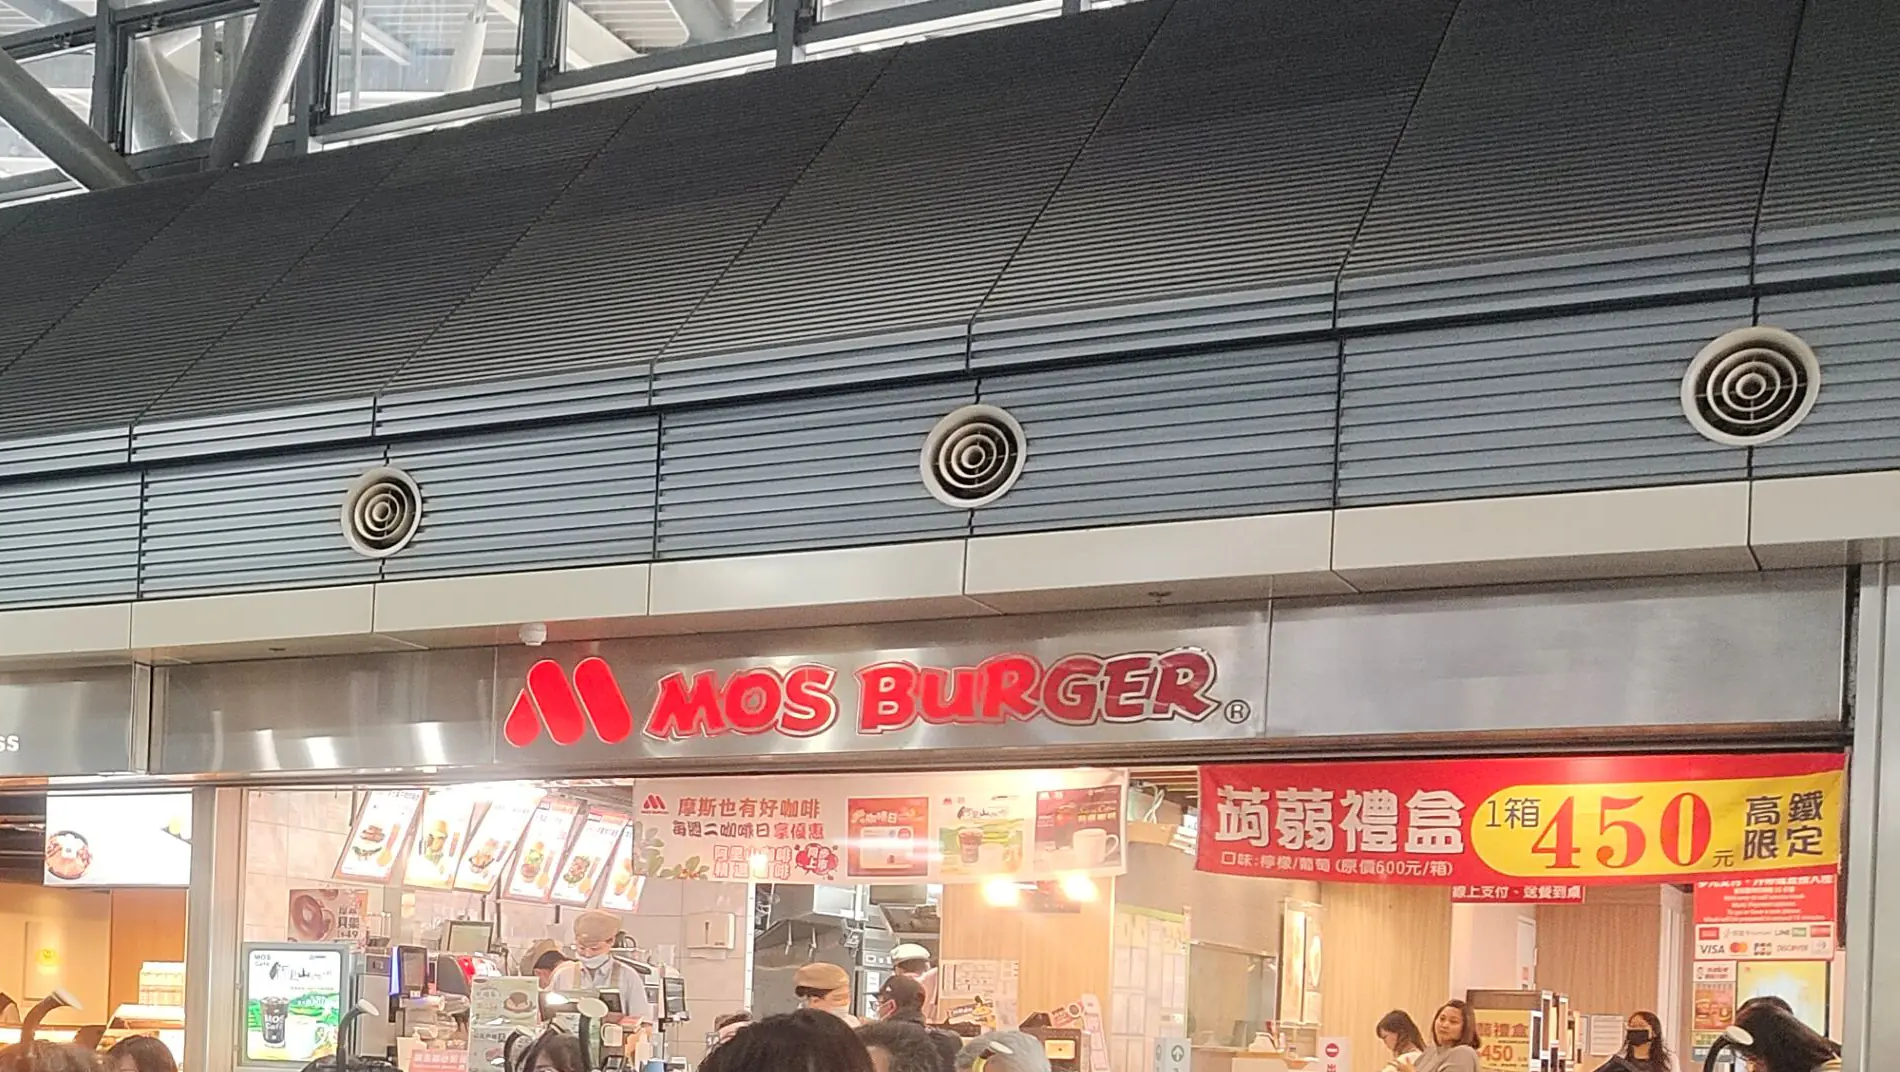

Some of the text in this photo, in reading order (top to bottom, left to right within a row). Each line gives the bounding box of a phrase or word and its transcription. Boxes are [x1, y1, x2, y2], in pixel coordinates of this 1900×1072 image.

[643, 662, 840, 742] MOS
[853, 646, 1222, 735] BURGER
[677, 798, 821, 819] 摩斯也有好咖啡
[1215, 785, 1466, 855] 蒟蒻禮盒
[1745, 790, 1824, 826] 高鐵
[1485, 793, 1734, 869] 1箱 450 元
[1742, 826, 1824, 862] 限定
[1700, 944, 1725, 955] VISA
